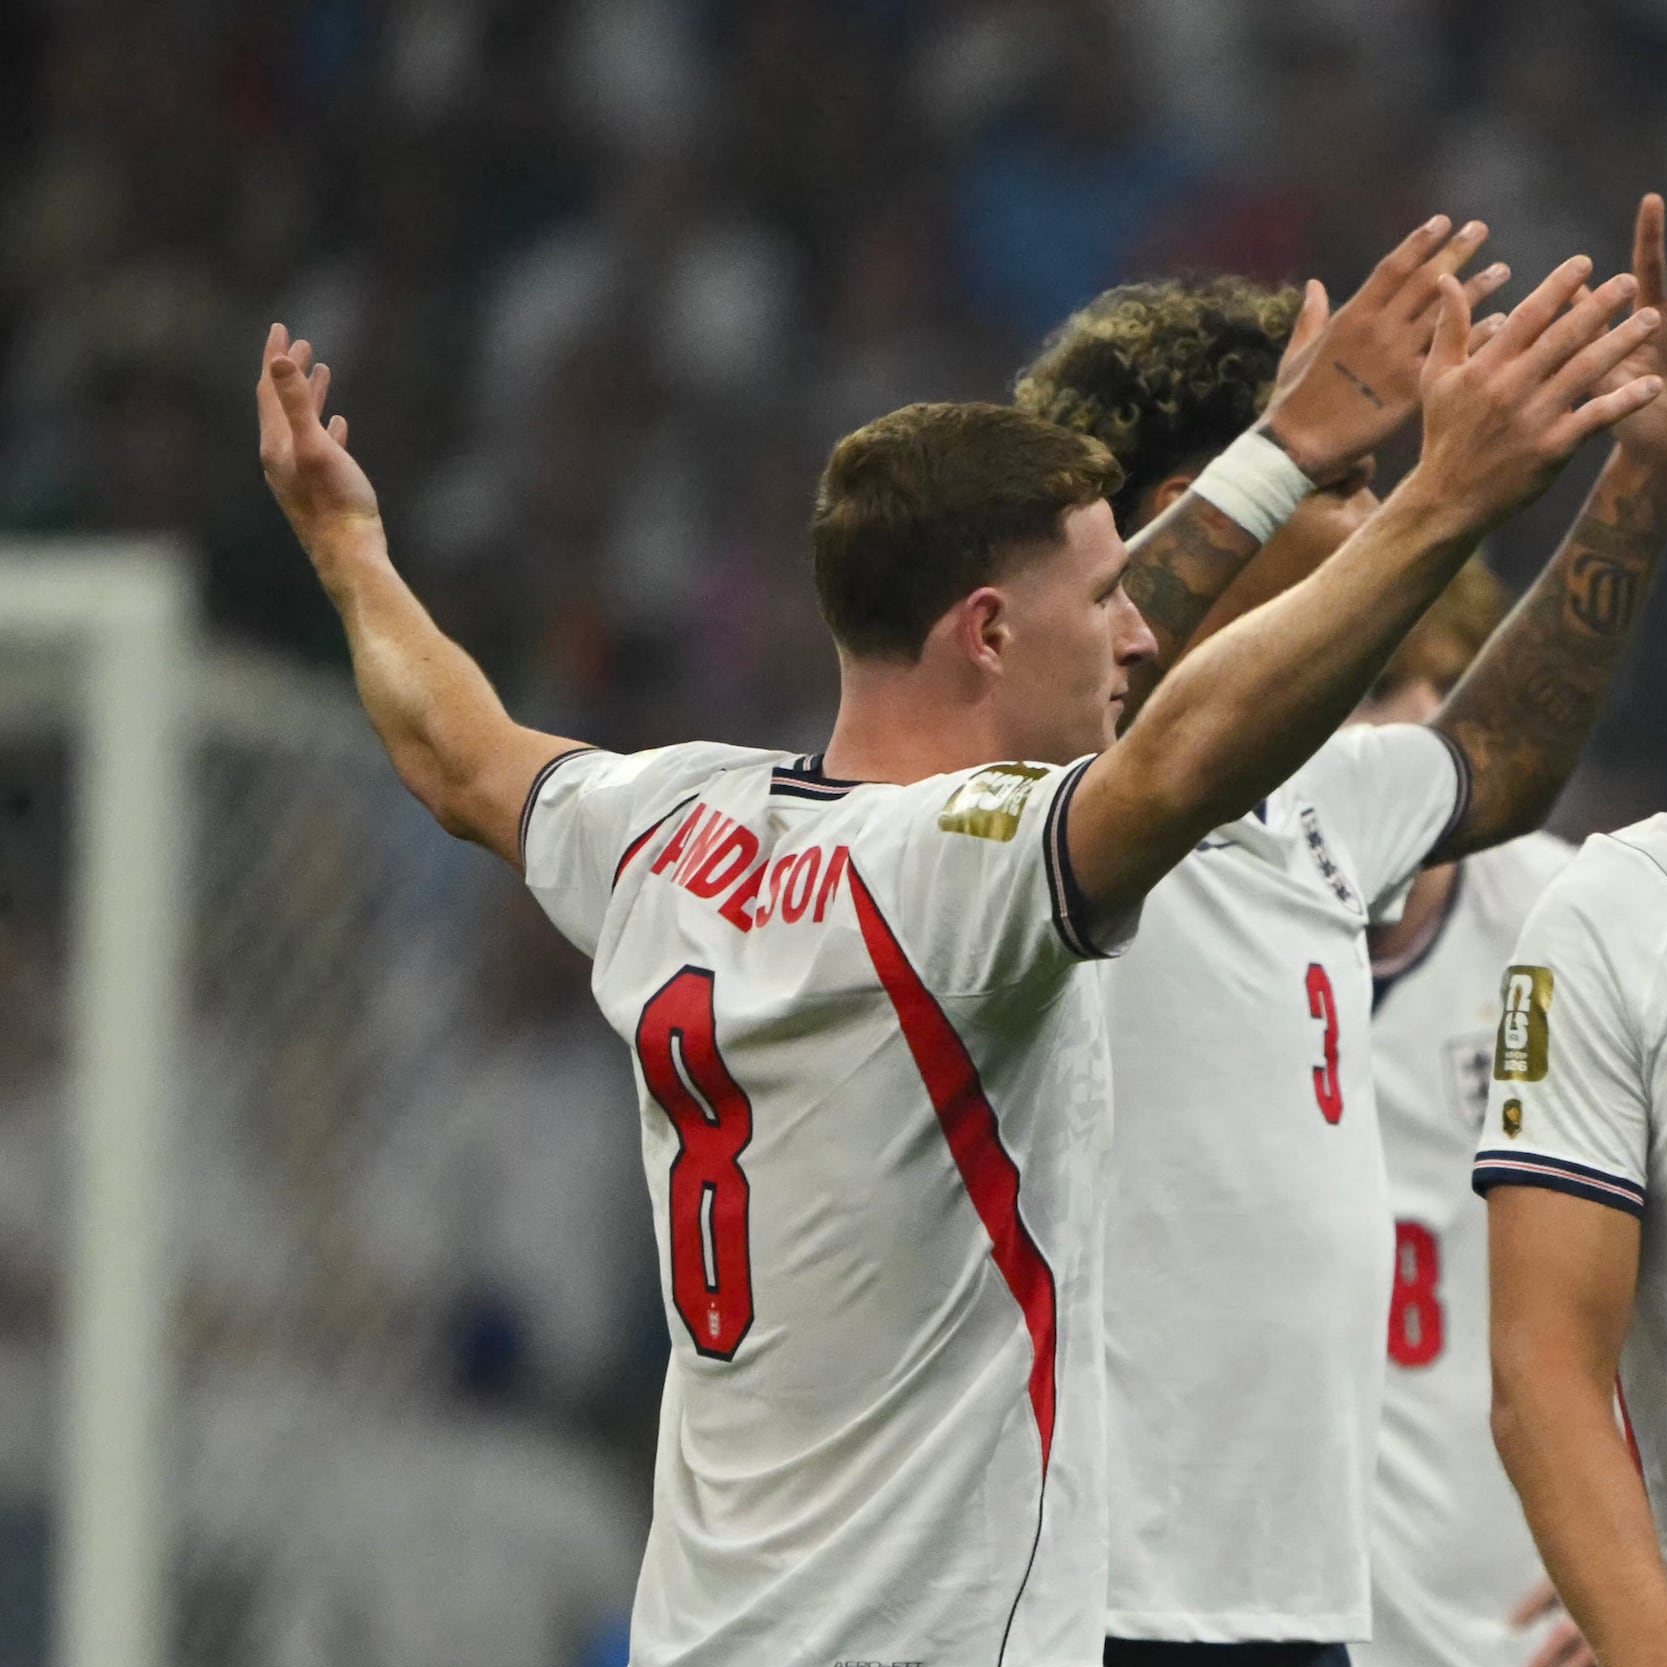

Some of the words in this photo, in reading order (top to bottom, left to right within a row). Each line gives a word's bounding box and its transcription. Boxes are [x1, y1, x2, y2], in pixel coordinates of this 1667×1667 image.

[650, 802, 850, 934] ANDESON
[1304, 962, 1344, 1126] 3
[635, 964, 755, 1362] 8
